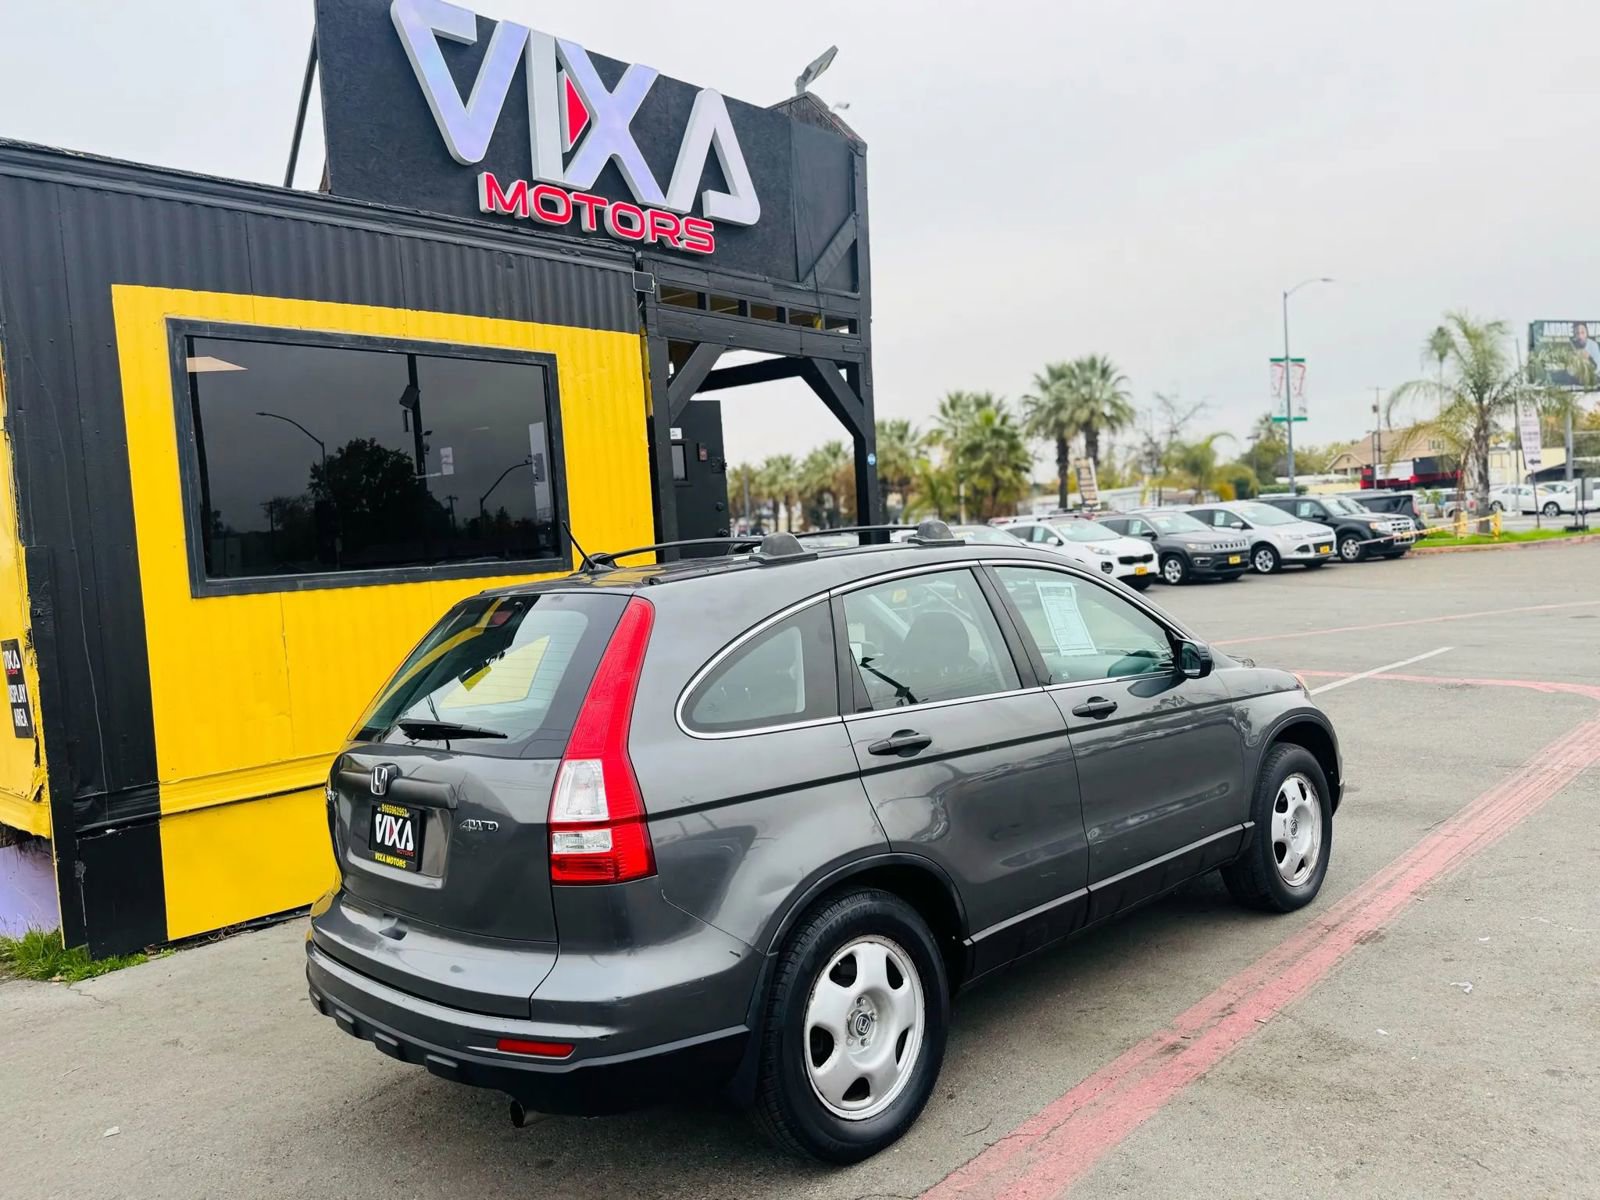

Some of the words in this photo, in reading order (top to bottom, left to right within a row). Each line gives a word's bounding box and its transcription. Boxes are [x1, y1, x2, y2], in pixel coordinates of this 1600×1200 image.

[391, 0, 760, 226] VIXA
[477, 171, 715, 255] MOTORS
[14, 708, 28, 727] AREA
[375, 813, 414, 851] VIXA
[460, 819, 498, 831] 4WD
[375, 852, 385, 862] VIXA
[386, 855, 406, 868] MOTORS
